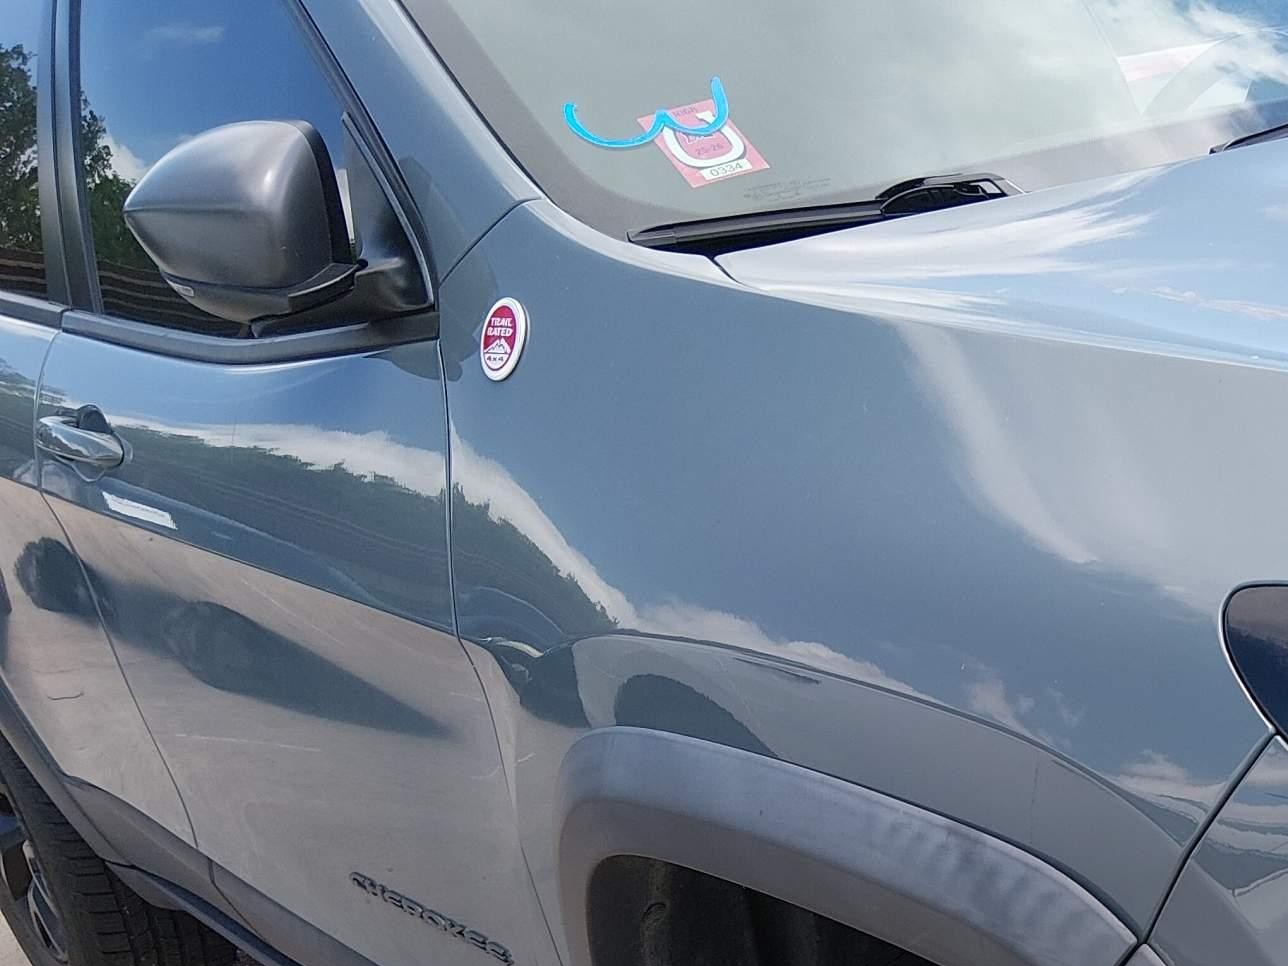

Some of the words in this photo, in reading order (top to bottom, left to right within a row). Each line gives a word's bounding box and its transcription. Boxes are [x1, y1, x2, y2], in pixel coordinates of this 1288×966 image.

[709, 162, 744, 177] 0334
[490, 317, 513, 327] TRAIL
[486, 327, 513, 337] RATED
